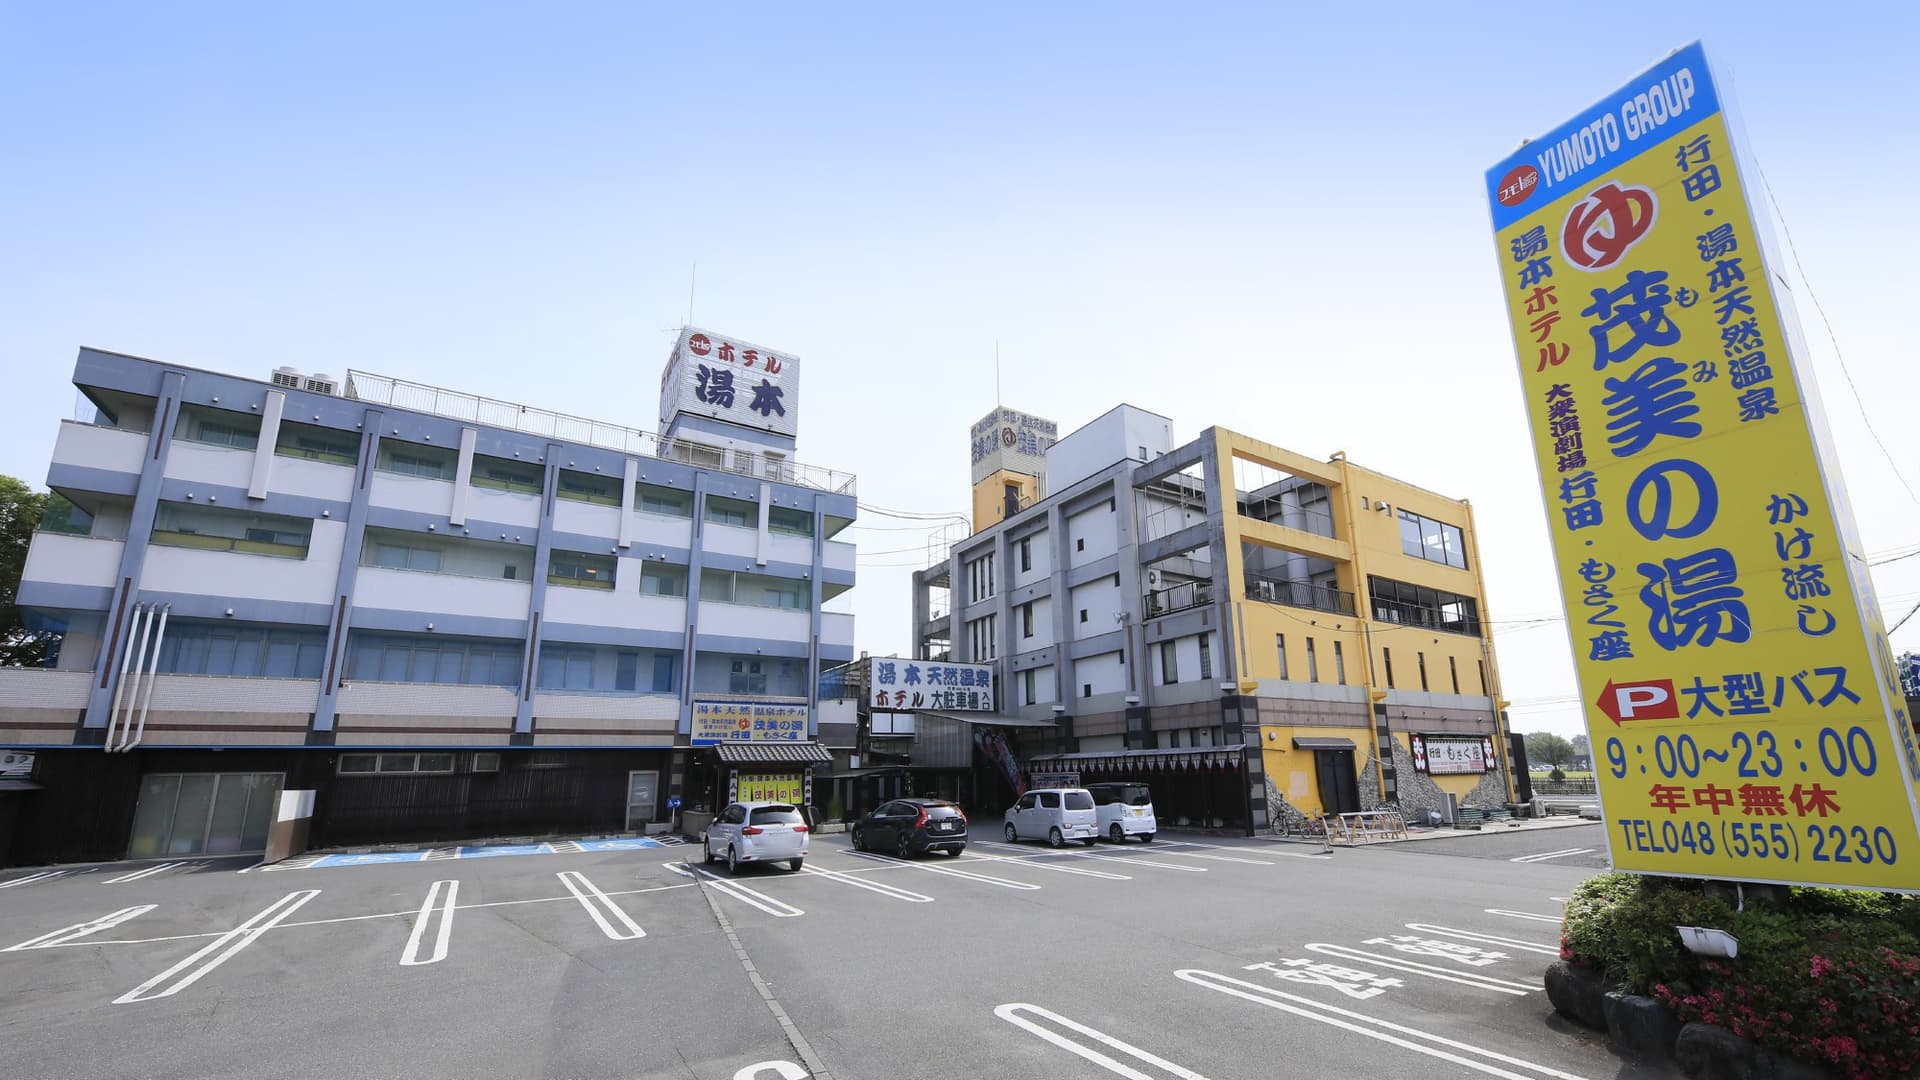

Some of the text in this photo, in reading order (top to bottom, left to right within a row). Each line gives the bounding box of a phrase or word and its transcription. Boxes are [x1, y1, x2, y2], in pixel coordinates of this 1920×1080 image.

[1537, 67, 1695, 188] YUMOTO GROUP
[1560, 178, 1660, 273] ゆ
[1674, 286, 1699, 308] も
[718, 342, 782, 375] ホテル
[1510, 224, 1570, 373] 湯本ホテル
[1544, 383, 1587, 473] 大衆演劇場
[1692, 360, 1718, 383] み
[695, 363, 786, 418] 湯本
[1581, 270, 1752, 652] 茂美の湯
[1766, 493, 1837, 637] かけ流し
[878, 662, 990, 688] 湯本天然温泉
[1681, 665, 1862, 720] 大型バス
[875, 689, 924, 708] ホテル
[931, 690, 979, 710] 大駐車場
[1614, 685, 1669, 718] P
[1648, 782, 1842, 818] 年中無休
